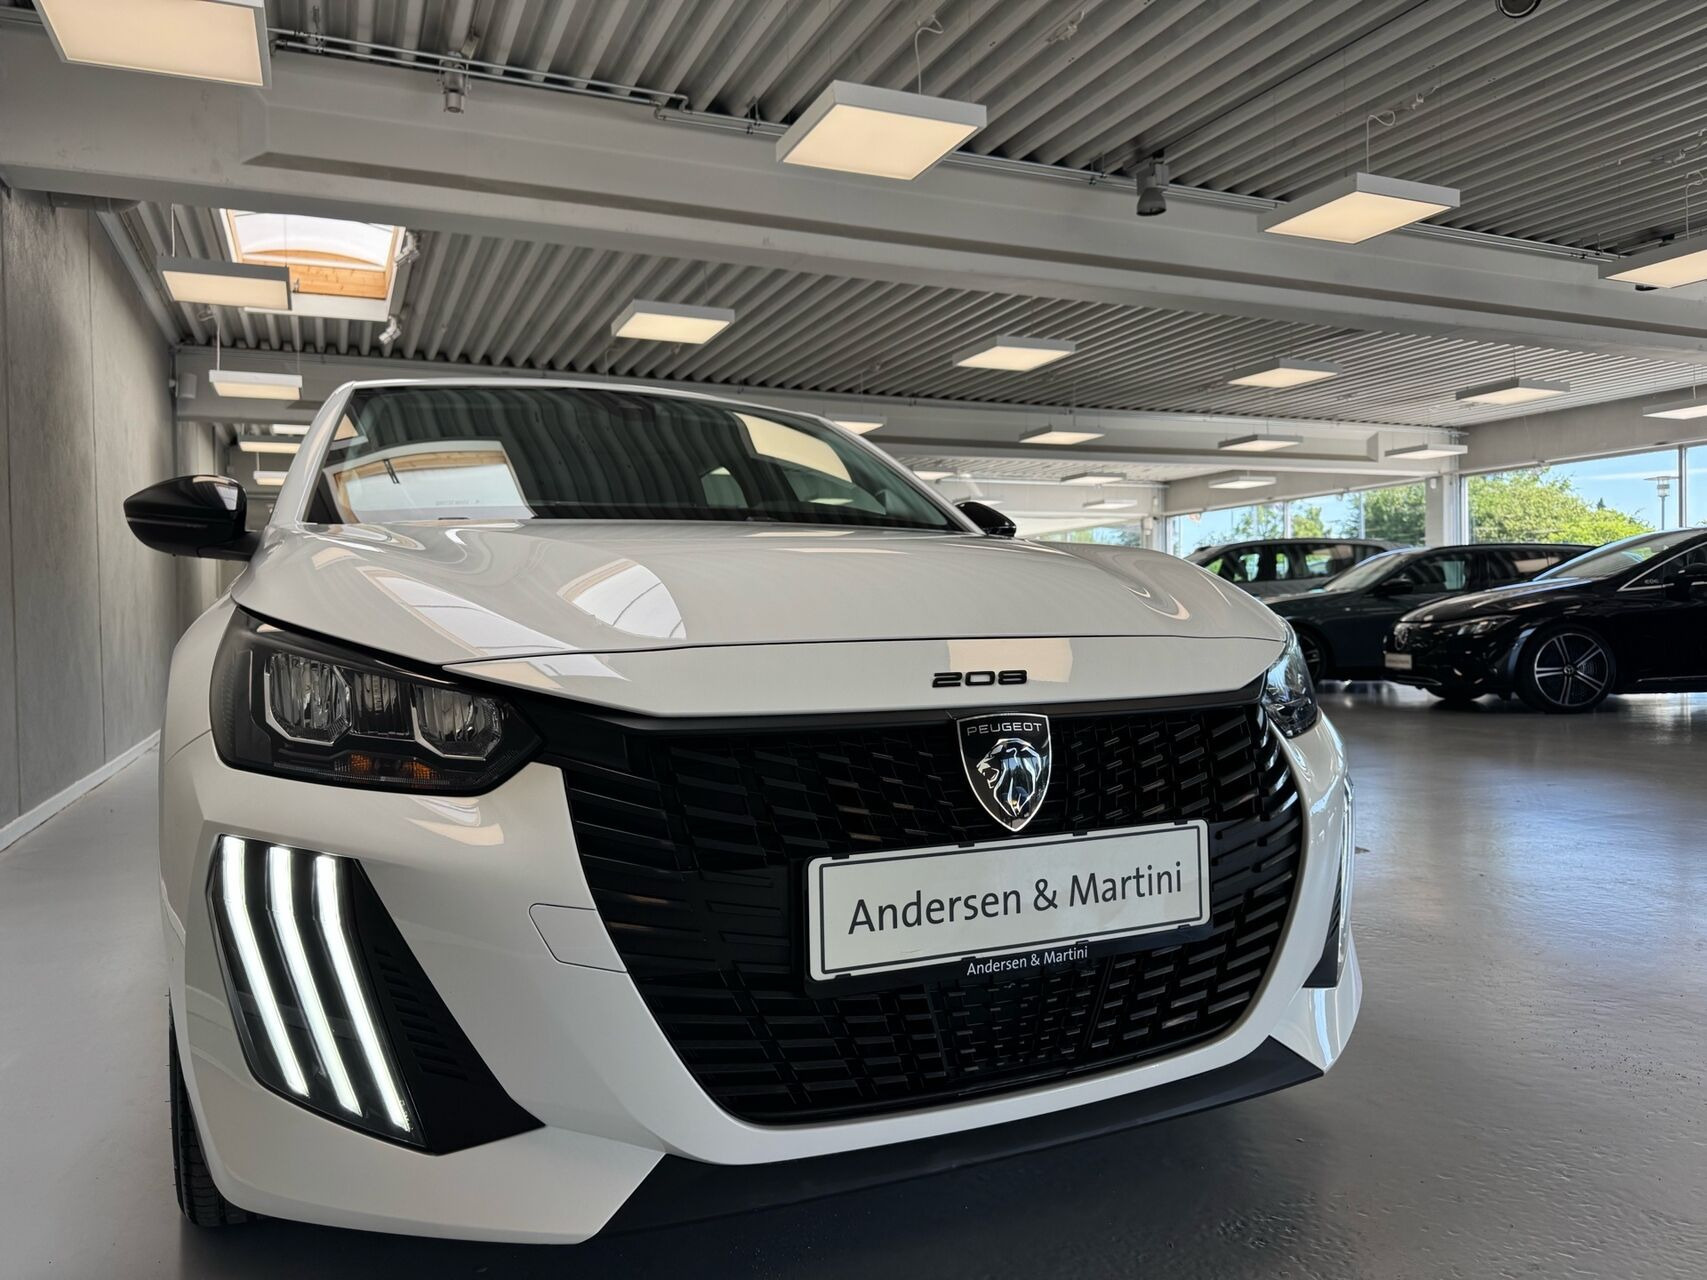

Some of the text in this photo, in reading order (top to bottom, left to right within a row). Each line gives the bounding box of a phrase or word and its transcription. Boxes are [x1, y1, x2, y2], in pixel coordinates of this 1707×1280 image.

[932, 670, 1027, 688] 208
[966, 722, 1042, 736] PEUGEOT
[848, 861, 1182, 935] Andersen & Martini
[967, 946, 1088, 976] Andersen & Martini
